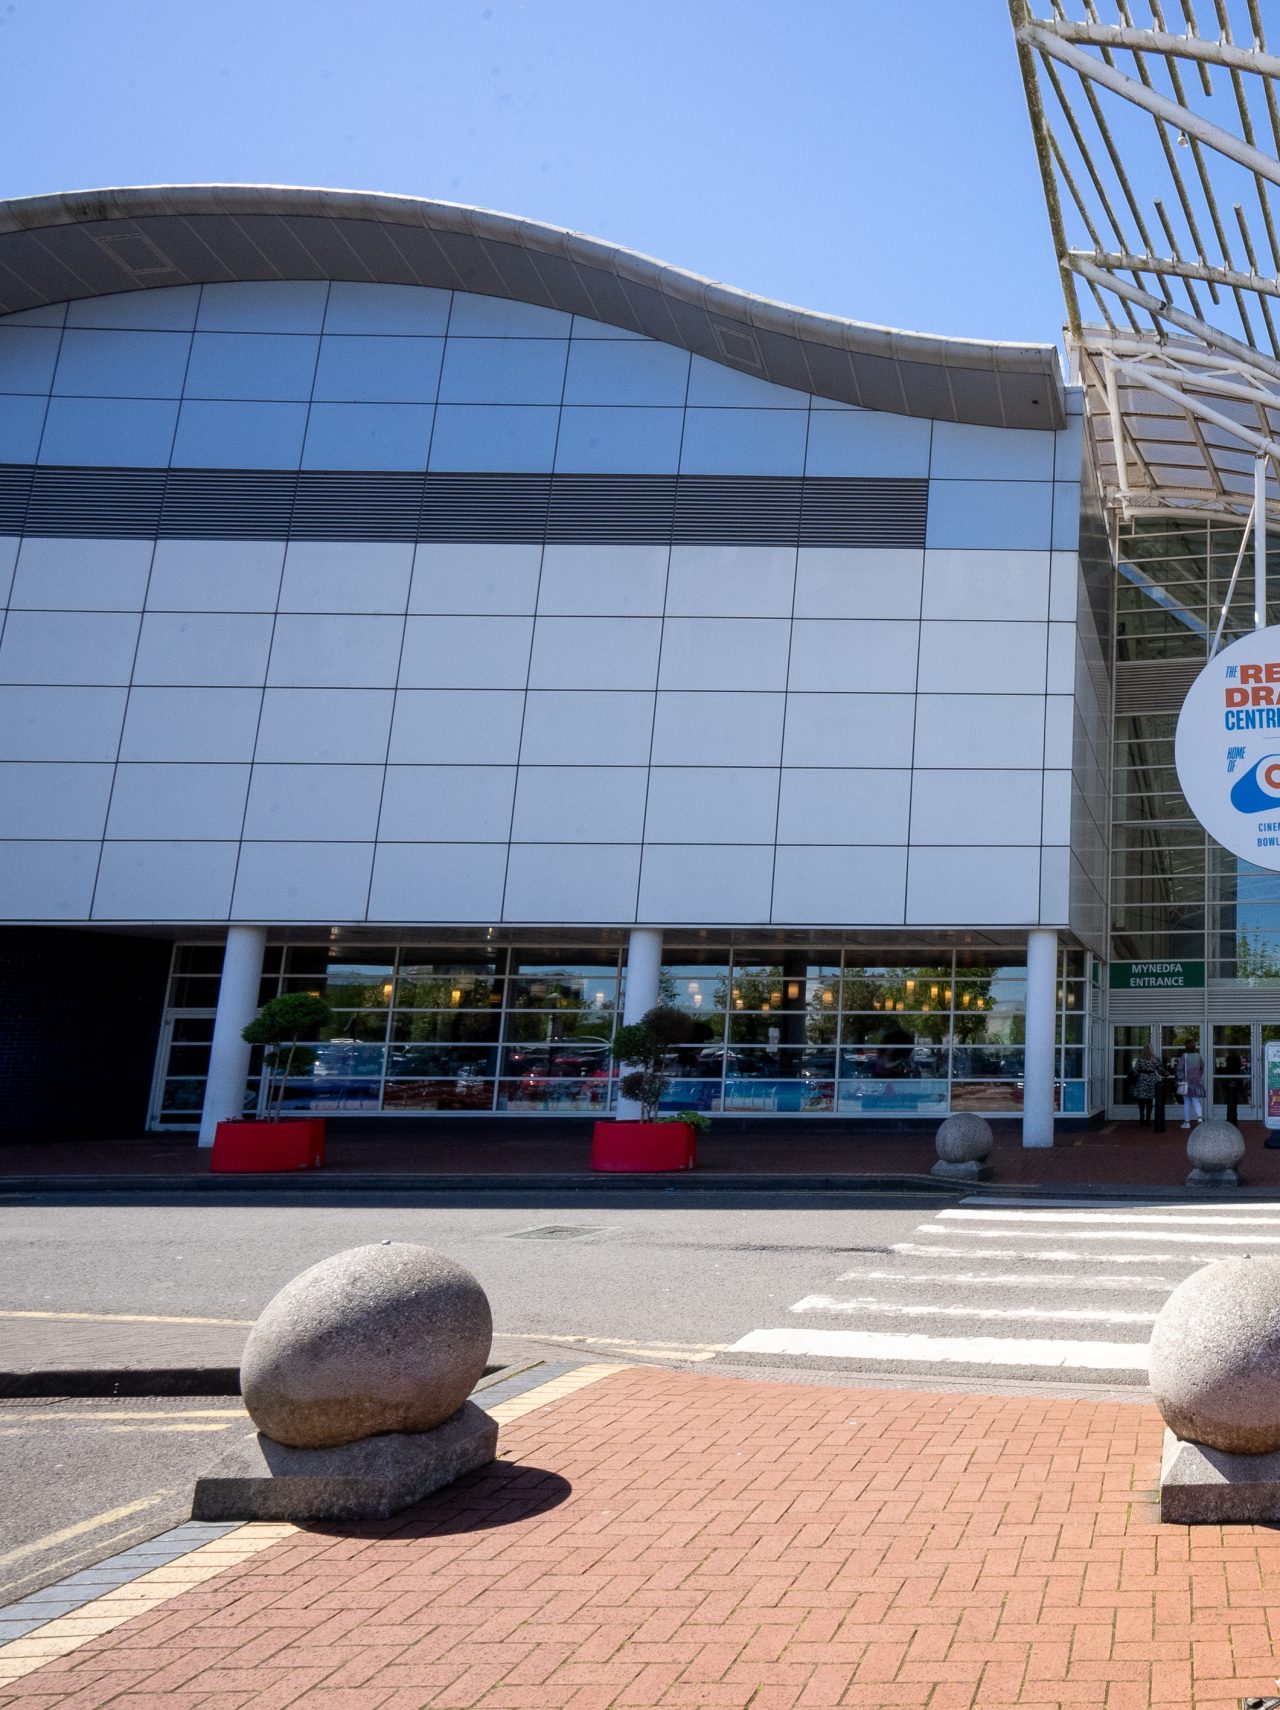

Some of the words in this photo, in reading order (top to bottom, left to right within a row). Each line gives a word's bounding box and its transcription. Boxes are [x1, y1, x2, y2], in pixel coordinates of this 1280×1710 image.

[1226, 665, 1238, 678] THE
[1227, 746, 1246, 759] HOME
[1131, 963, 1183, 973] MYNEDFA
[1130, 977, 1184, 987] ENTRANCE
